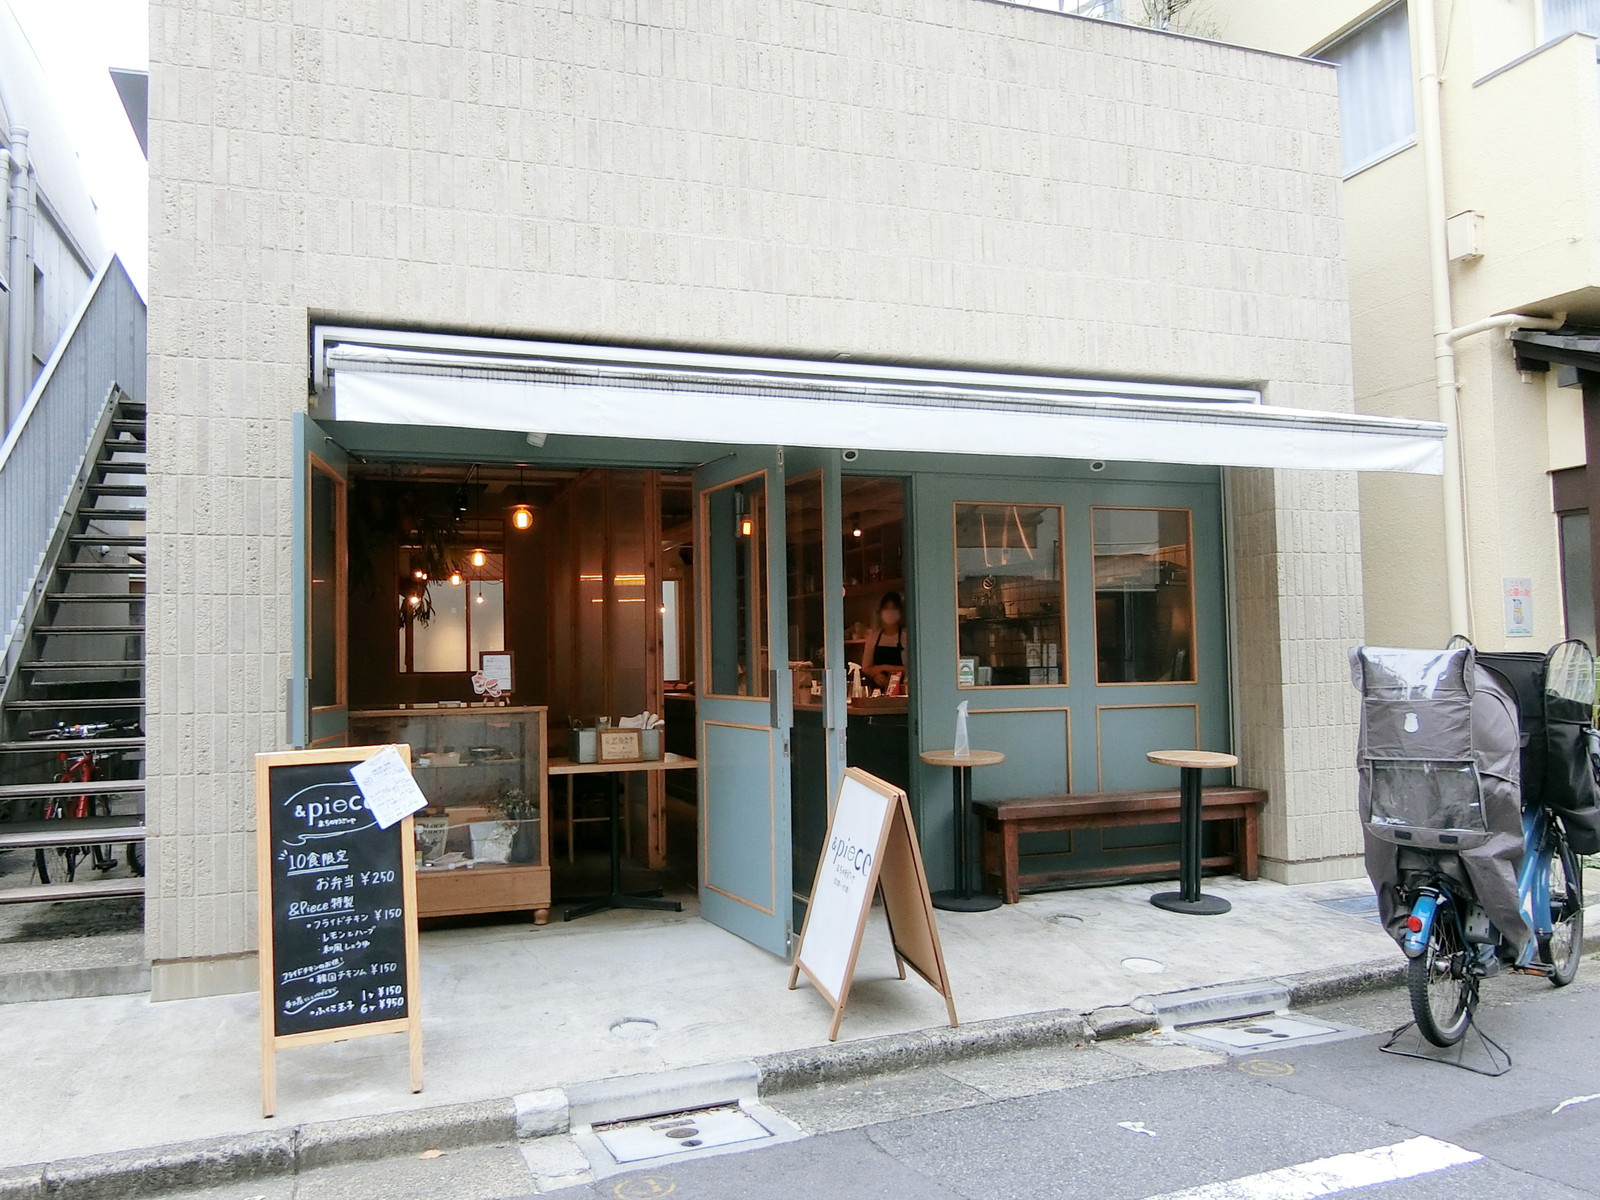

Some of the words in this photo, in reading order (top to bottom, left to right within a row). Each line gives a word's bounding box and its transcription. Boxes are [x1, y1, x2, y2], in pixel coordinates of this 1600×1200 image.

[288, 849, 350, 870] 10食限定
[831, 837, 872, 877] &piece
[316, 874, 354, 891] お弁当
[360, 870, 395, 886] ¥250
[374, 908, 402, 920] ¥150
[322, 925, 377, 942] レモンとハーブ
[370, 962, 397, 975] ¥150
[378, 985, 402, 997] ¥150
[379, 997, 404, 1010] ¥950
